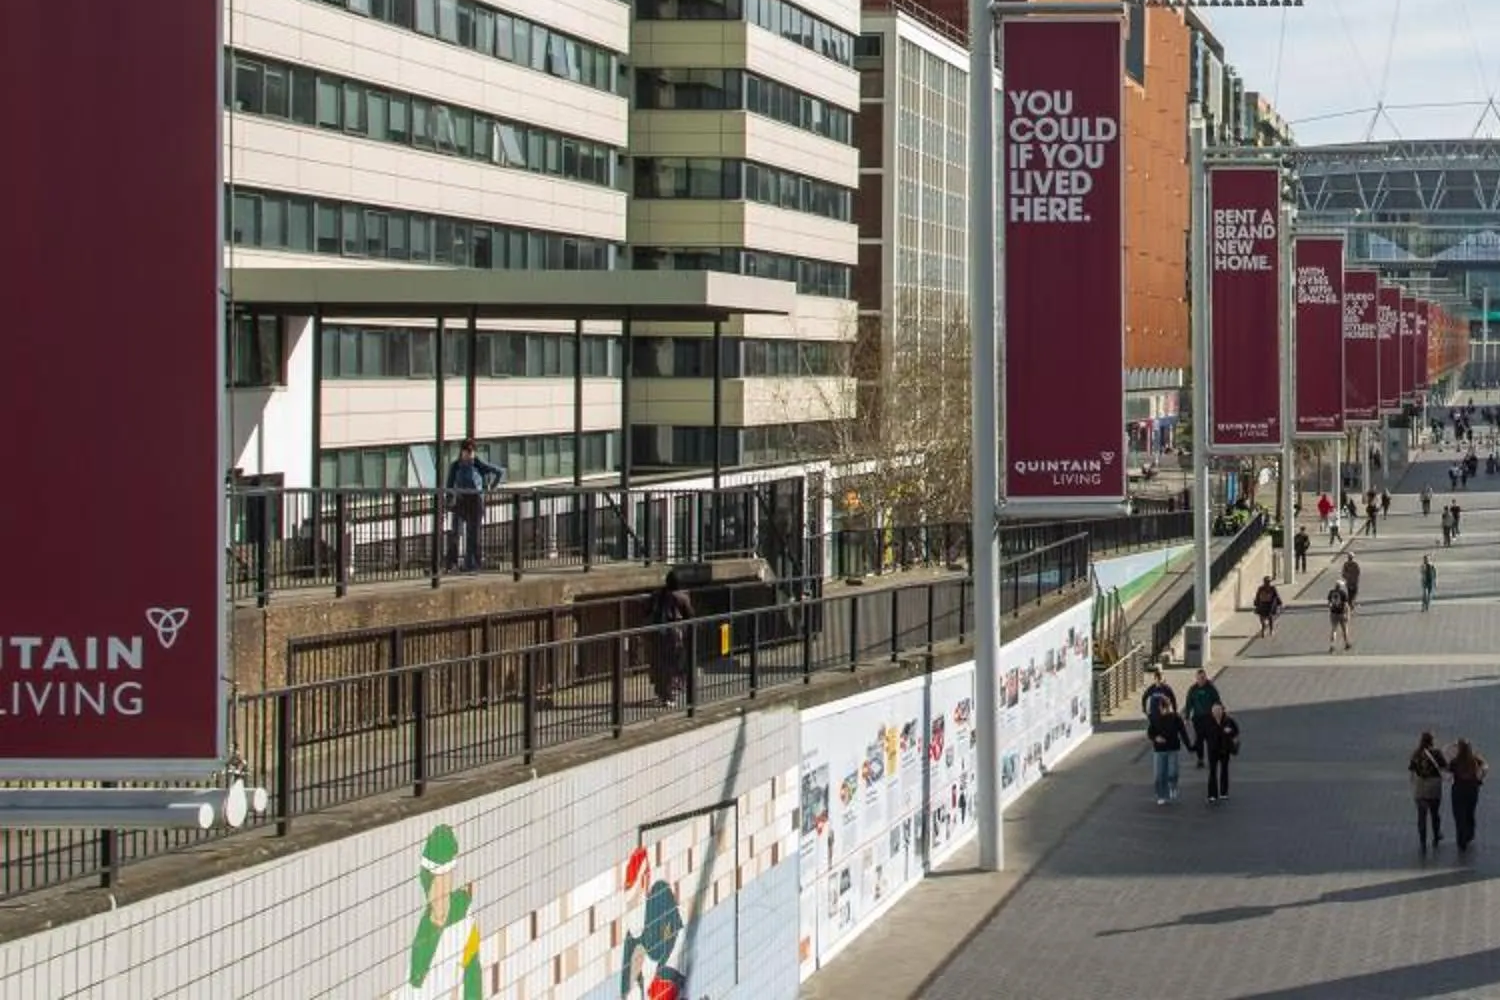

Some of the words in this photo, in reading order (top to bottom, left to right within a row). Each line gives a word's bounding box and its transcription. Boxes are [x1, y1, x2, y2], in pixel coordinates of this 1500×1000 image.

[1009, 89, 1073, 115] YOU
[1009, 116, 1117, 142] COULD
[1010, 143, 1033, 169] IF
[1040, 143, 1104, 169] YOU
[1010, 169, 1092, 195] LIVED
[1010, 196, 1091, 222] HERE.
[1215, 209, 1257, 224] RENT
[1261, 208, 1275, 224] A
[1215, 225, 1276, 239] BRAND
[1215, 239, 1254, 254] NEW
[1215, 255, 1273, 270] HOME.
[1015, 460, 1101, 474] QUINTAIN
[1053, 473, 1101, 485] LIVING
[0, 636, 143, 669] TAIN
[0, 681, 143, 716] IVING
